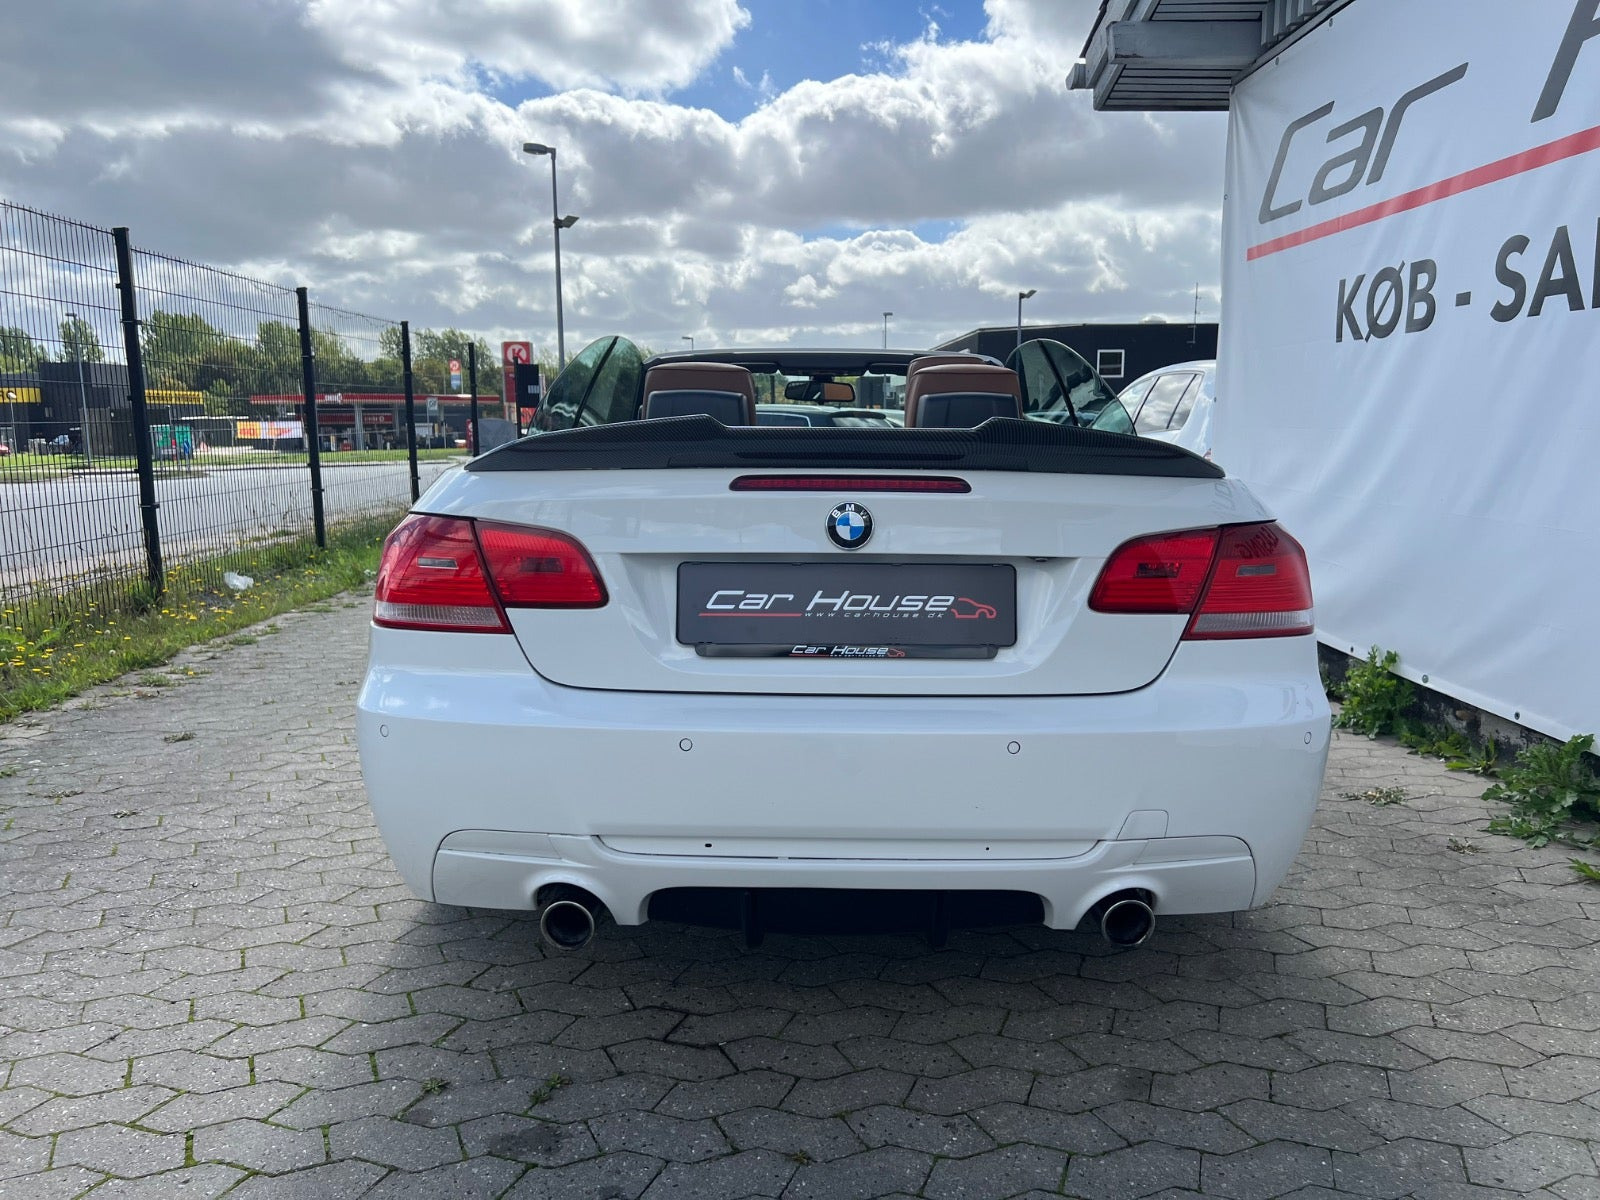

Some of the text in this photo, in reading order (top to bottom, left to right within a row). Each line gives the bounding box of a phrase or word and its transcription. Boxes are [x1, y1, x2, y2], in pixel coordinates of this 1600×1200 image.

[1258, 61, 1469, 225] Car
[1335, 258, 1437, 343] KØB
[706, 590, 794, 609] Car
[791, 645, 826, 653] Car
